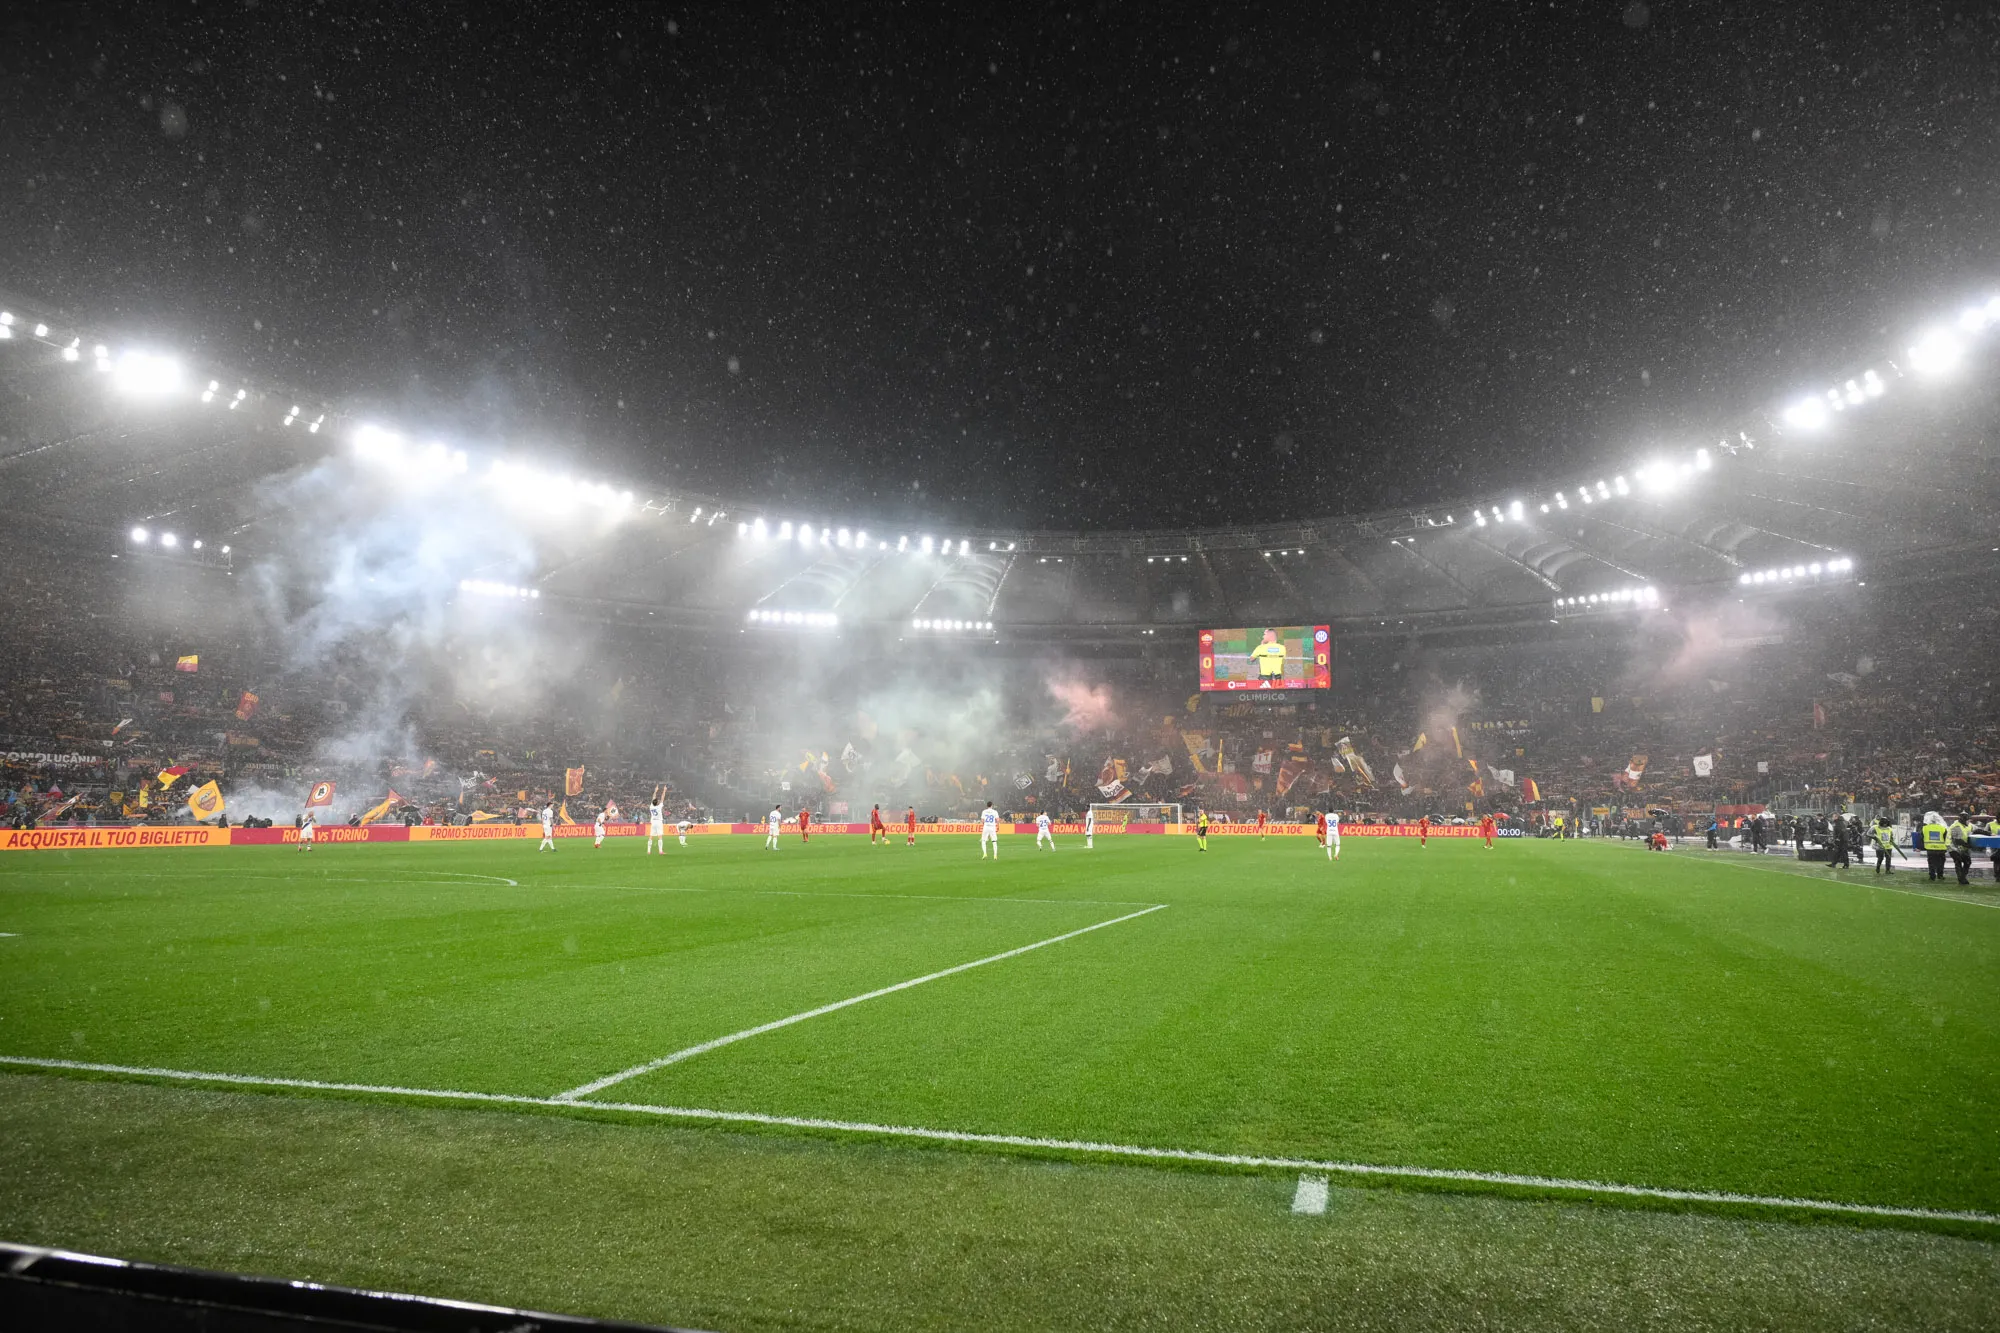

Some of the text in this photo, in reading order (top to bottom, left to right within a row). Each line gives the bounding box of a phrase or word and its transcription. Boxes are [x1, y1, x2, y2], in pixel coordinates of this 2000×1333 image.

[1202, 657, 1212, 669] 0
[1317, 653, 1327, 665] 0
[1239, 693, 1285, 702] OLIMPICO
[985, 814, 994, 823] 28
[430, 827, 527, 838] PROMO STUDENTI DA 10€
[553, 826, 586, 837] ACQUISTA
[607, 825, 637, 835] BIGLIETTO
[826, 824, 848, 833] 18:30
[927, 824, 935, 833] IL
[936, 824, 953, 833] TUO
[1053, 824, 1079, 833] ROMA
[1270, 825, 1283, 834] DA
[1286, 825, 1303, 834] 10€
[1342, 826, 1392, 836] ACQUISTA
[1393, 826, 1402, 835] IL
[1427, 826, 1480, 836] BIGLIETTO
[1497, 828, 1520, 836] 00:00
[330, 828, 369, 840] TORINO
[7, 831, 209, 849] ACQUISTA IL TUO BIGLIETTO
